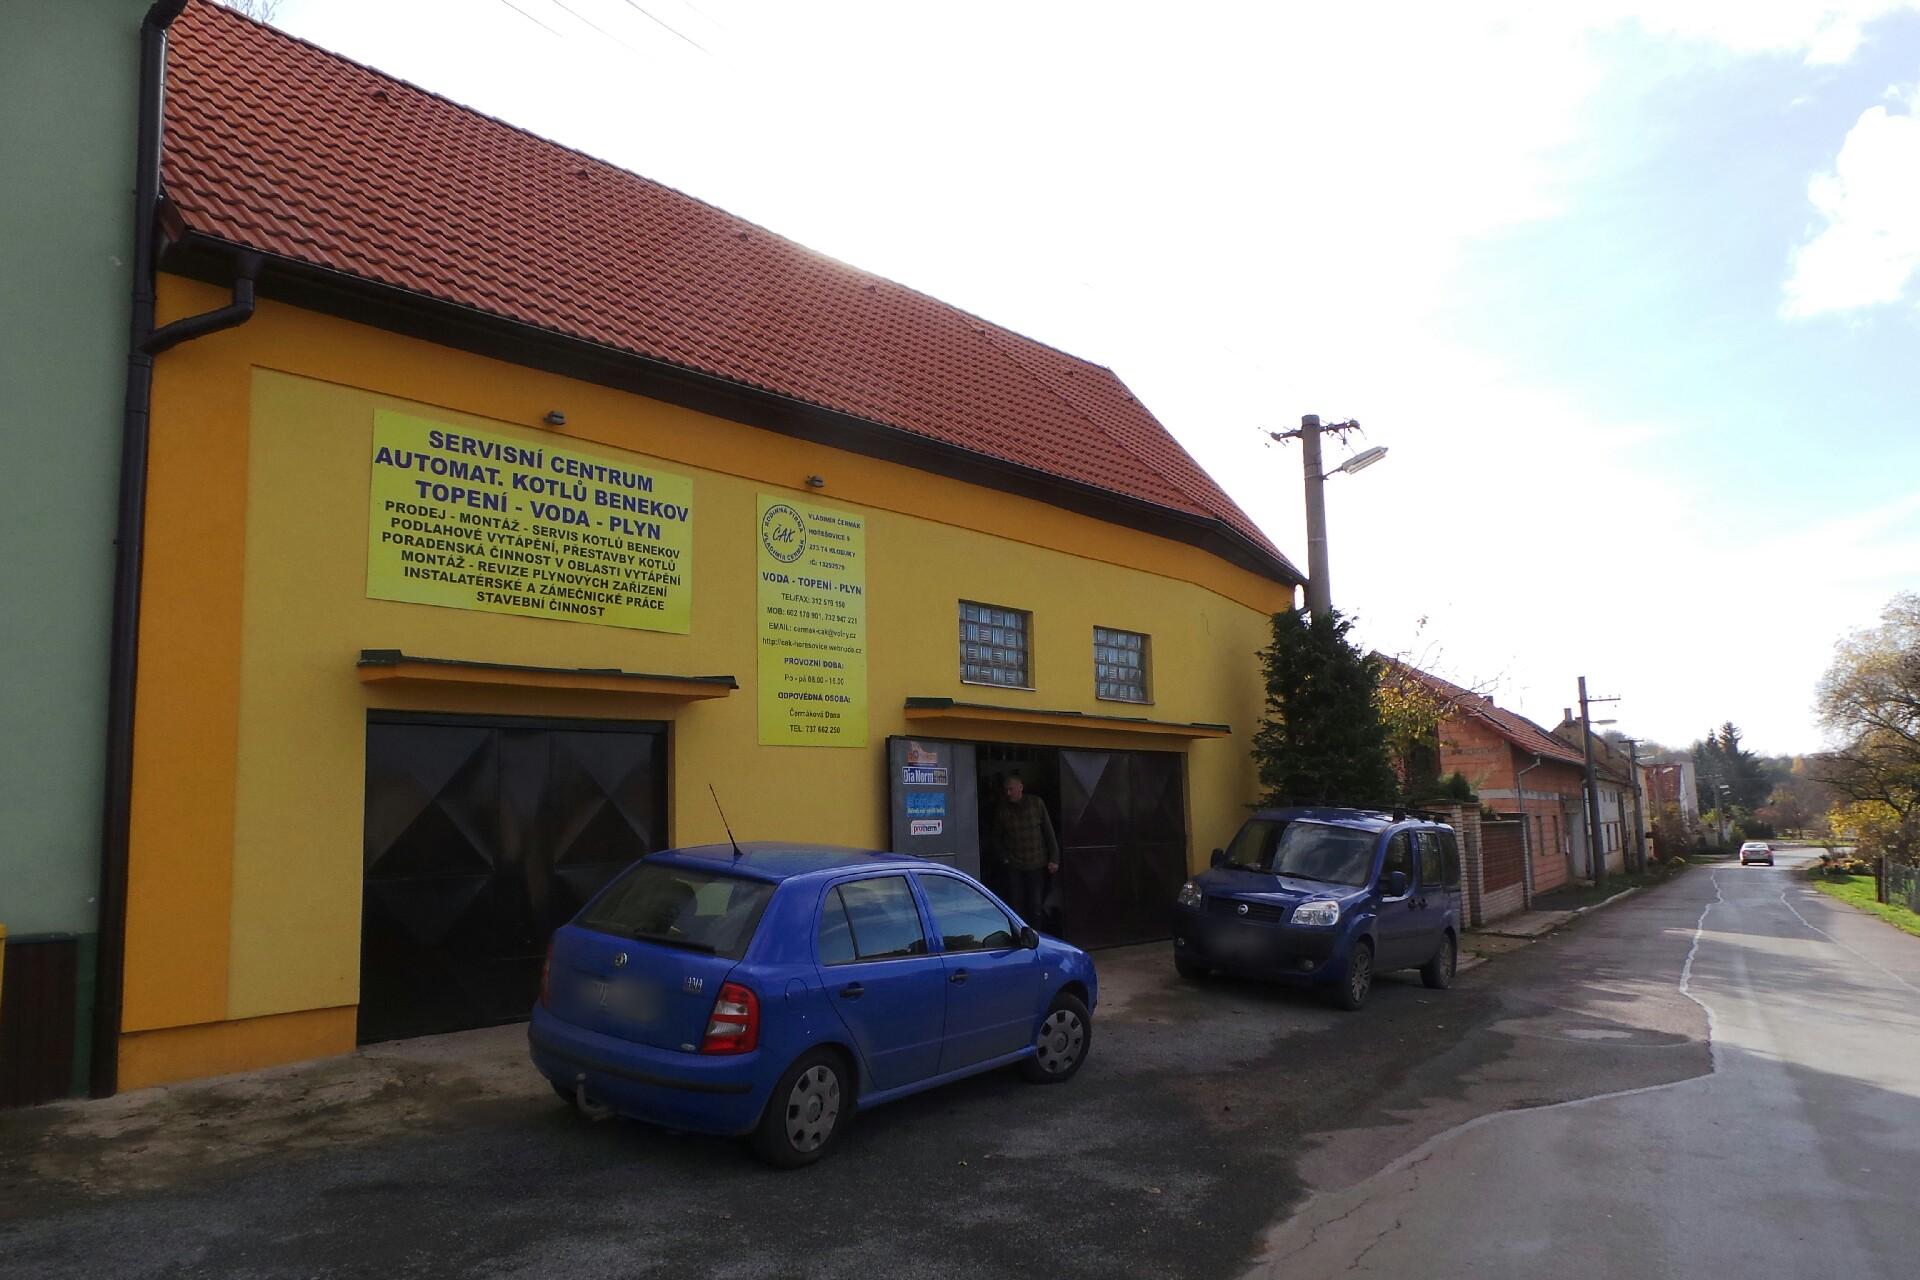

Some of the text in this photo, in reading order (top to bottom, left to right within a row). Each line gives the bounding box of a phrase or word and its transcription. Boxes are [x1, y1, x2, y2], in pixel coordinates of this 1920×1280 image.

[375, 446, 689, 522] AUTOMAT. KOTLŮ BENEKOV
[429, 430, 653, 492] SERVISNÍ CENTRUM
[385, 500, 446, 520] PRODEJ
[459, 512, 520, 532] MONTÁŽ
[532, 524, 578, 542] SERVIS
[582, 533, 623, 549] KOTLŮ
[627, 541, 680, 559] BENEKOV
[415, 480, 507, 512] TOPENÍ
[530, 500, 590, 528] VODA
[609, 515, 661, 540] PLYN
[772, 523, 796, 543] ČAK
[382, 531, 681, 586] PORADENSKÁ ČINNOST V OBLASTI VYTÁPĚNÍ
[391, 517, 676, 572] PODLAHOVÉ VYTÁPĚNÍ, PŘESTAVBY KOTLŮ
[401, 549, 465, 569] MONTÁŽ
[478, 560, 529, 578] REVIZE
[533, 568, 609, 589] PLYNOVÝCH
[612, 580, 667, 597] ZAŘÍZENÍ
[404, 566, 665, 611] INSTALATÉRSKÉ A ZÁMEČNICKÉ PRÁCE
[762, 571, 790, 584] VODA
[797, 577, 832, 591] TOPENÍ
[839, 583, 862, 595] PLYN
[476, 591, 606, 617] STAVEBNÍ ČINNOST
